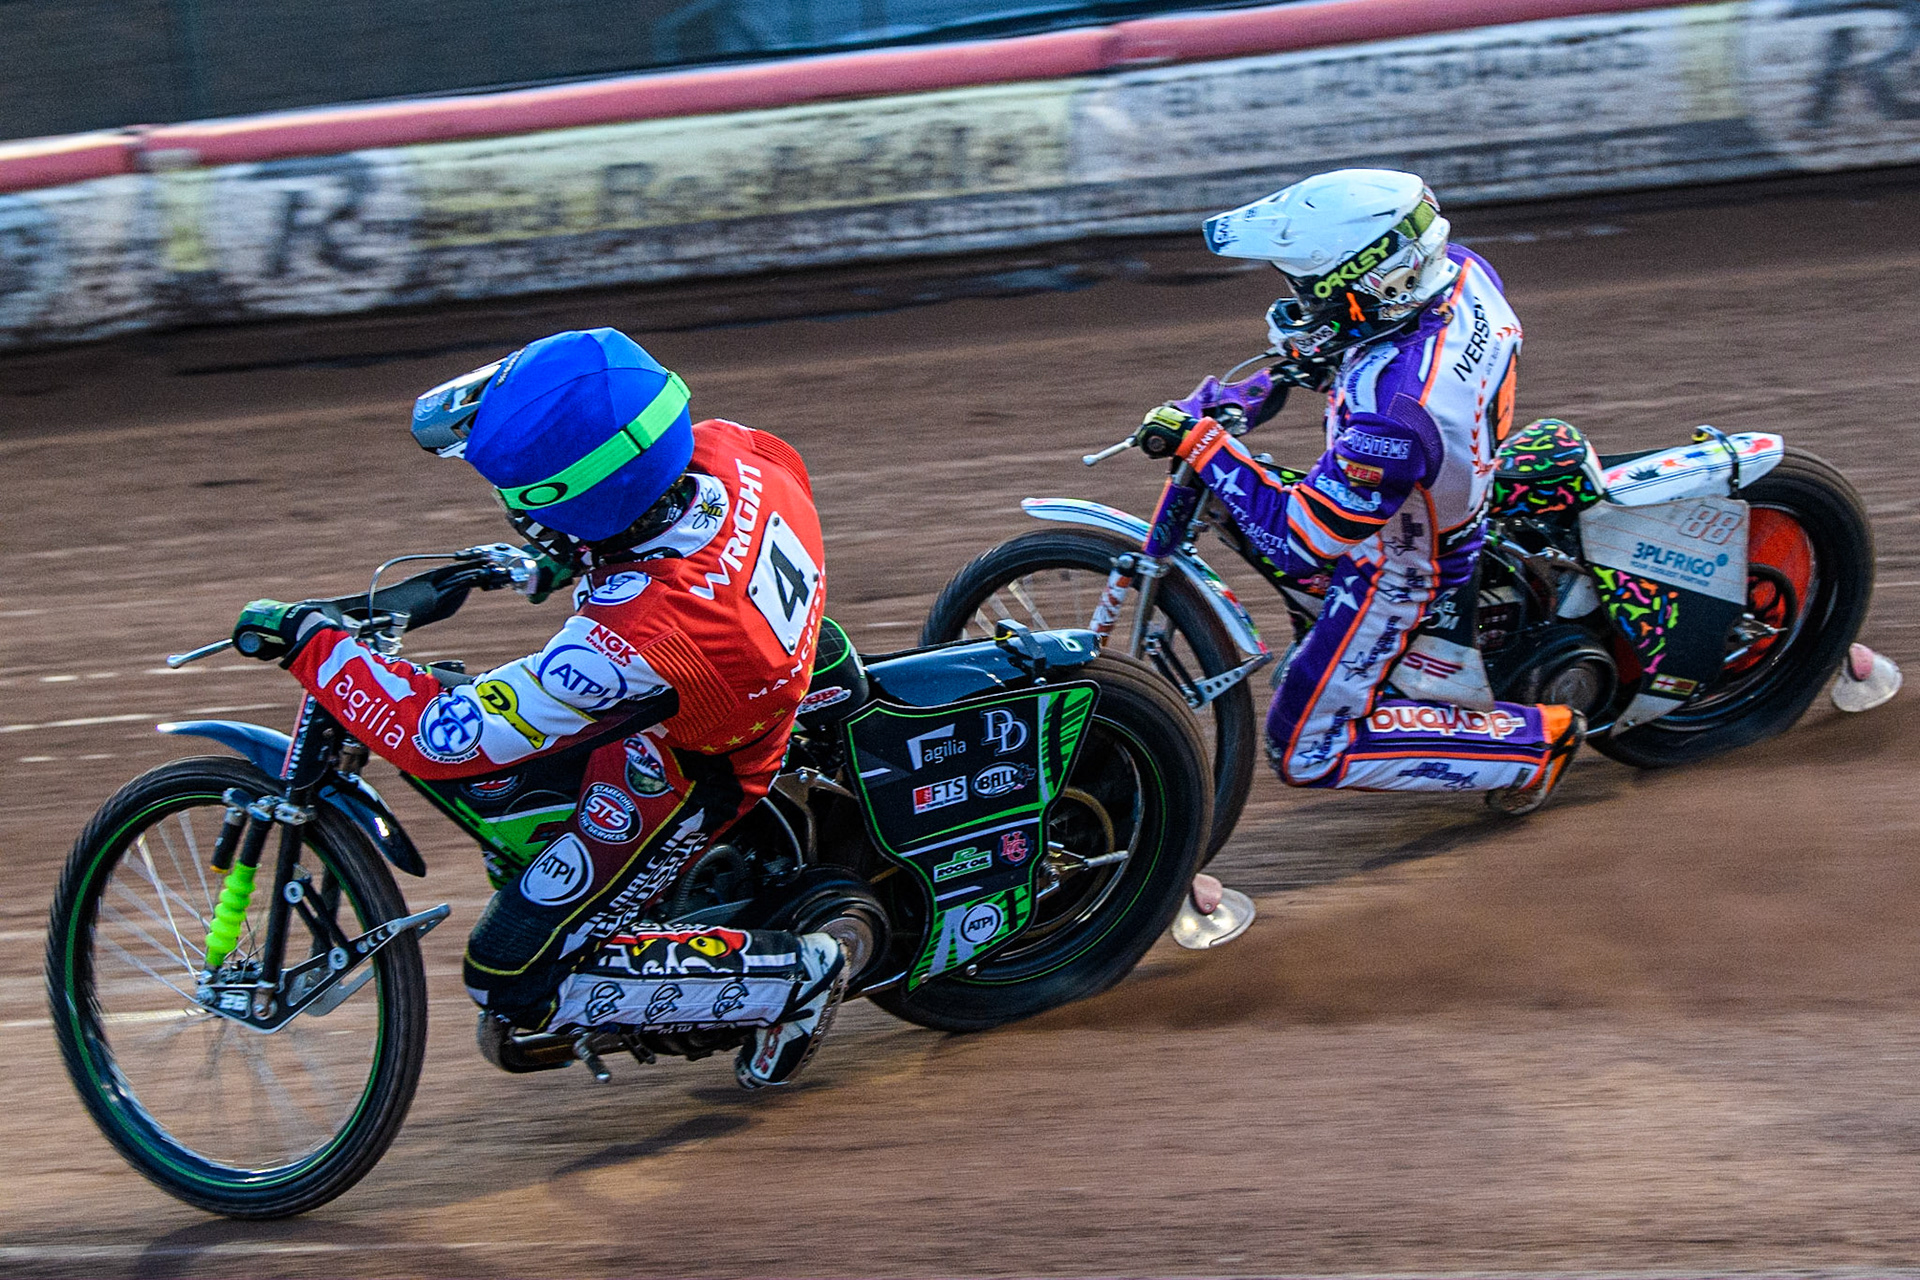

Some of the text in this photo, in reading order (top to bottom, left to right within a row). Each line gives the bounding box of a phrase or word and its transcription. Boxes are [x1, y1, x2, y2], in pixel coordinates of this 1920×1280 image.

[1313, 237, 1389, 298] OAKLEY
[689, 457, 763, 601] WRIGHT
[1679, 505, 1744, 545] 88
[1632, 541, 1716, 578] 3PLFRIGO
[770, 540, 811, 622] 4
[585, 635, 628, 668] SPARK PLUGS
[589, 624, 639, 666] NGK
[548, 662, 611, 699] ATPI
[334, 674, 406, 750] agilia
[1368, 705, 1516, 740] daytona
[923, 739, 967, 764] agilia
[591, 784, 635, 812] STAKEFORD
[930, 777, 966, 799] FTS
[586, 796, 629, 828] STS
[537, 855, 576, 886] ATPI
[609, 856, 663, 908] MALC
[936, 861, 967, 878] ROCK
[967, 914, 994, 934] ATPI
